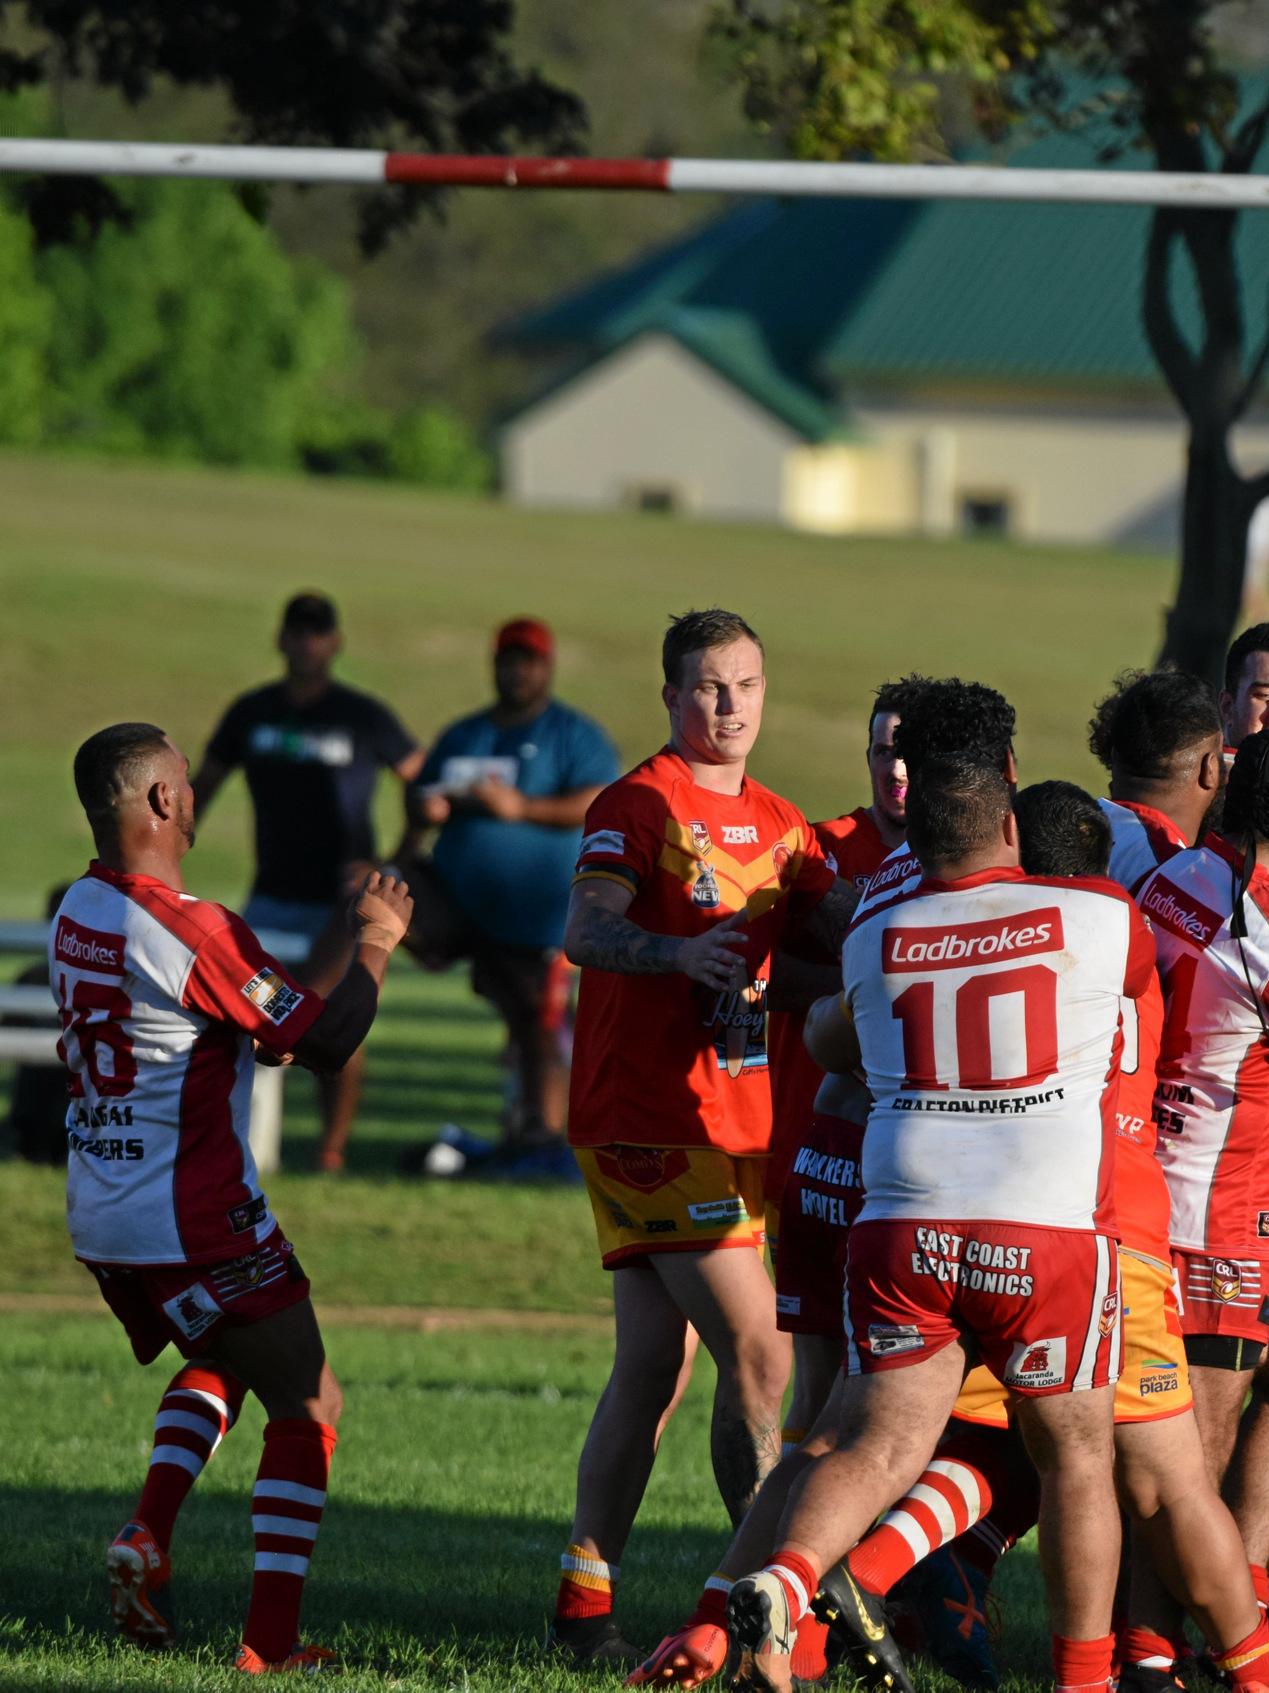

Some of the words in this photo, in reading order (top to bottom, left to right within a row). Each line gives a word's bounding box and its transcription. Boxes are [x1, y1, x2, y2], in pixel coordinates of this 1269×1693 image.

[722, 826, 759, 844] ZBR
[870, 857, 919, 891] Ladbro
[1144, 884, 1212, 942] Ladbrokes
[58, 926, 117, 966] Ladbrokes
[891, 923, 1051, 963] Ladbrokes
[892, 964, 1059, 1091] 10
[917, 1227, 963, 1257] EAST
[966, 1240, 1031, 1270] COAST
[1216, 1262, 1237, 1277] CRL
[1103, 1297, 1117, 1311] CRL
[1140, 1376, 1157, 1386] park
[1158, 1371, 1177, 1381] beach
[1140, 1379, 1178, 1397] plaza
